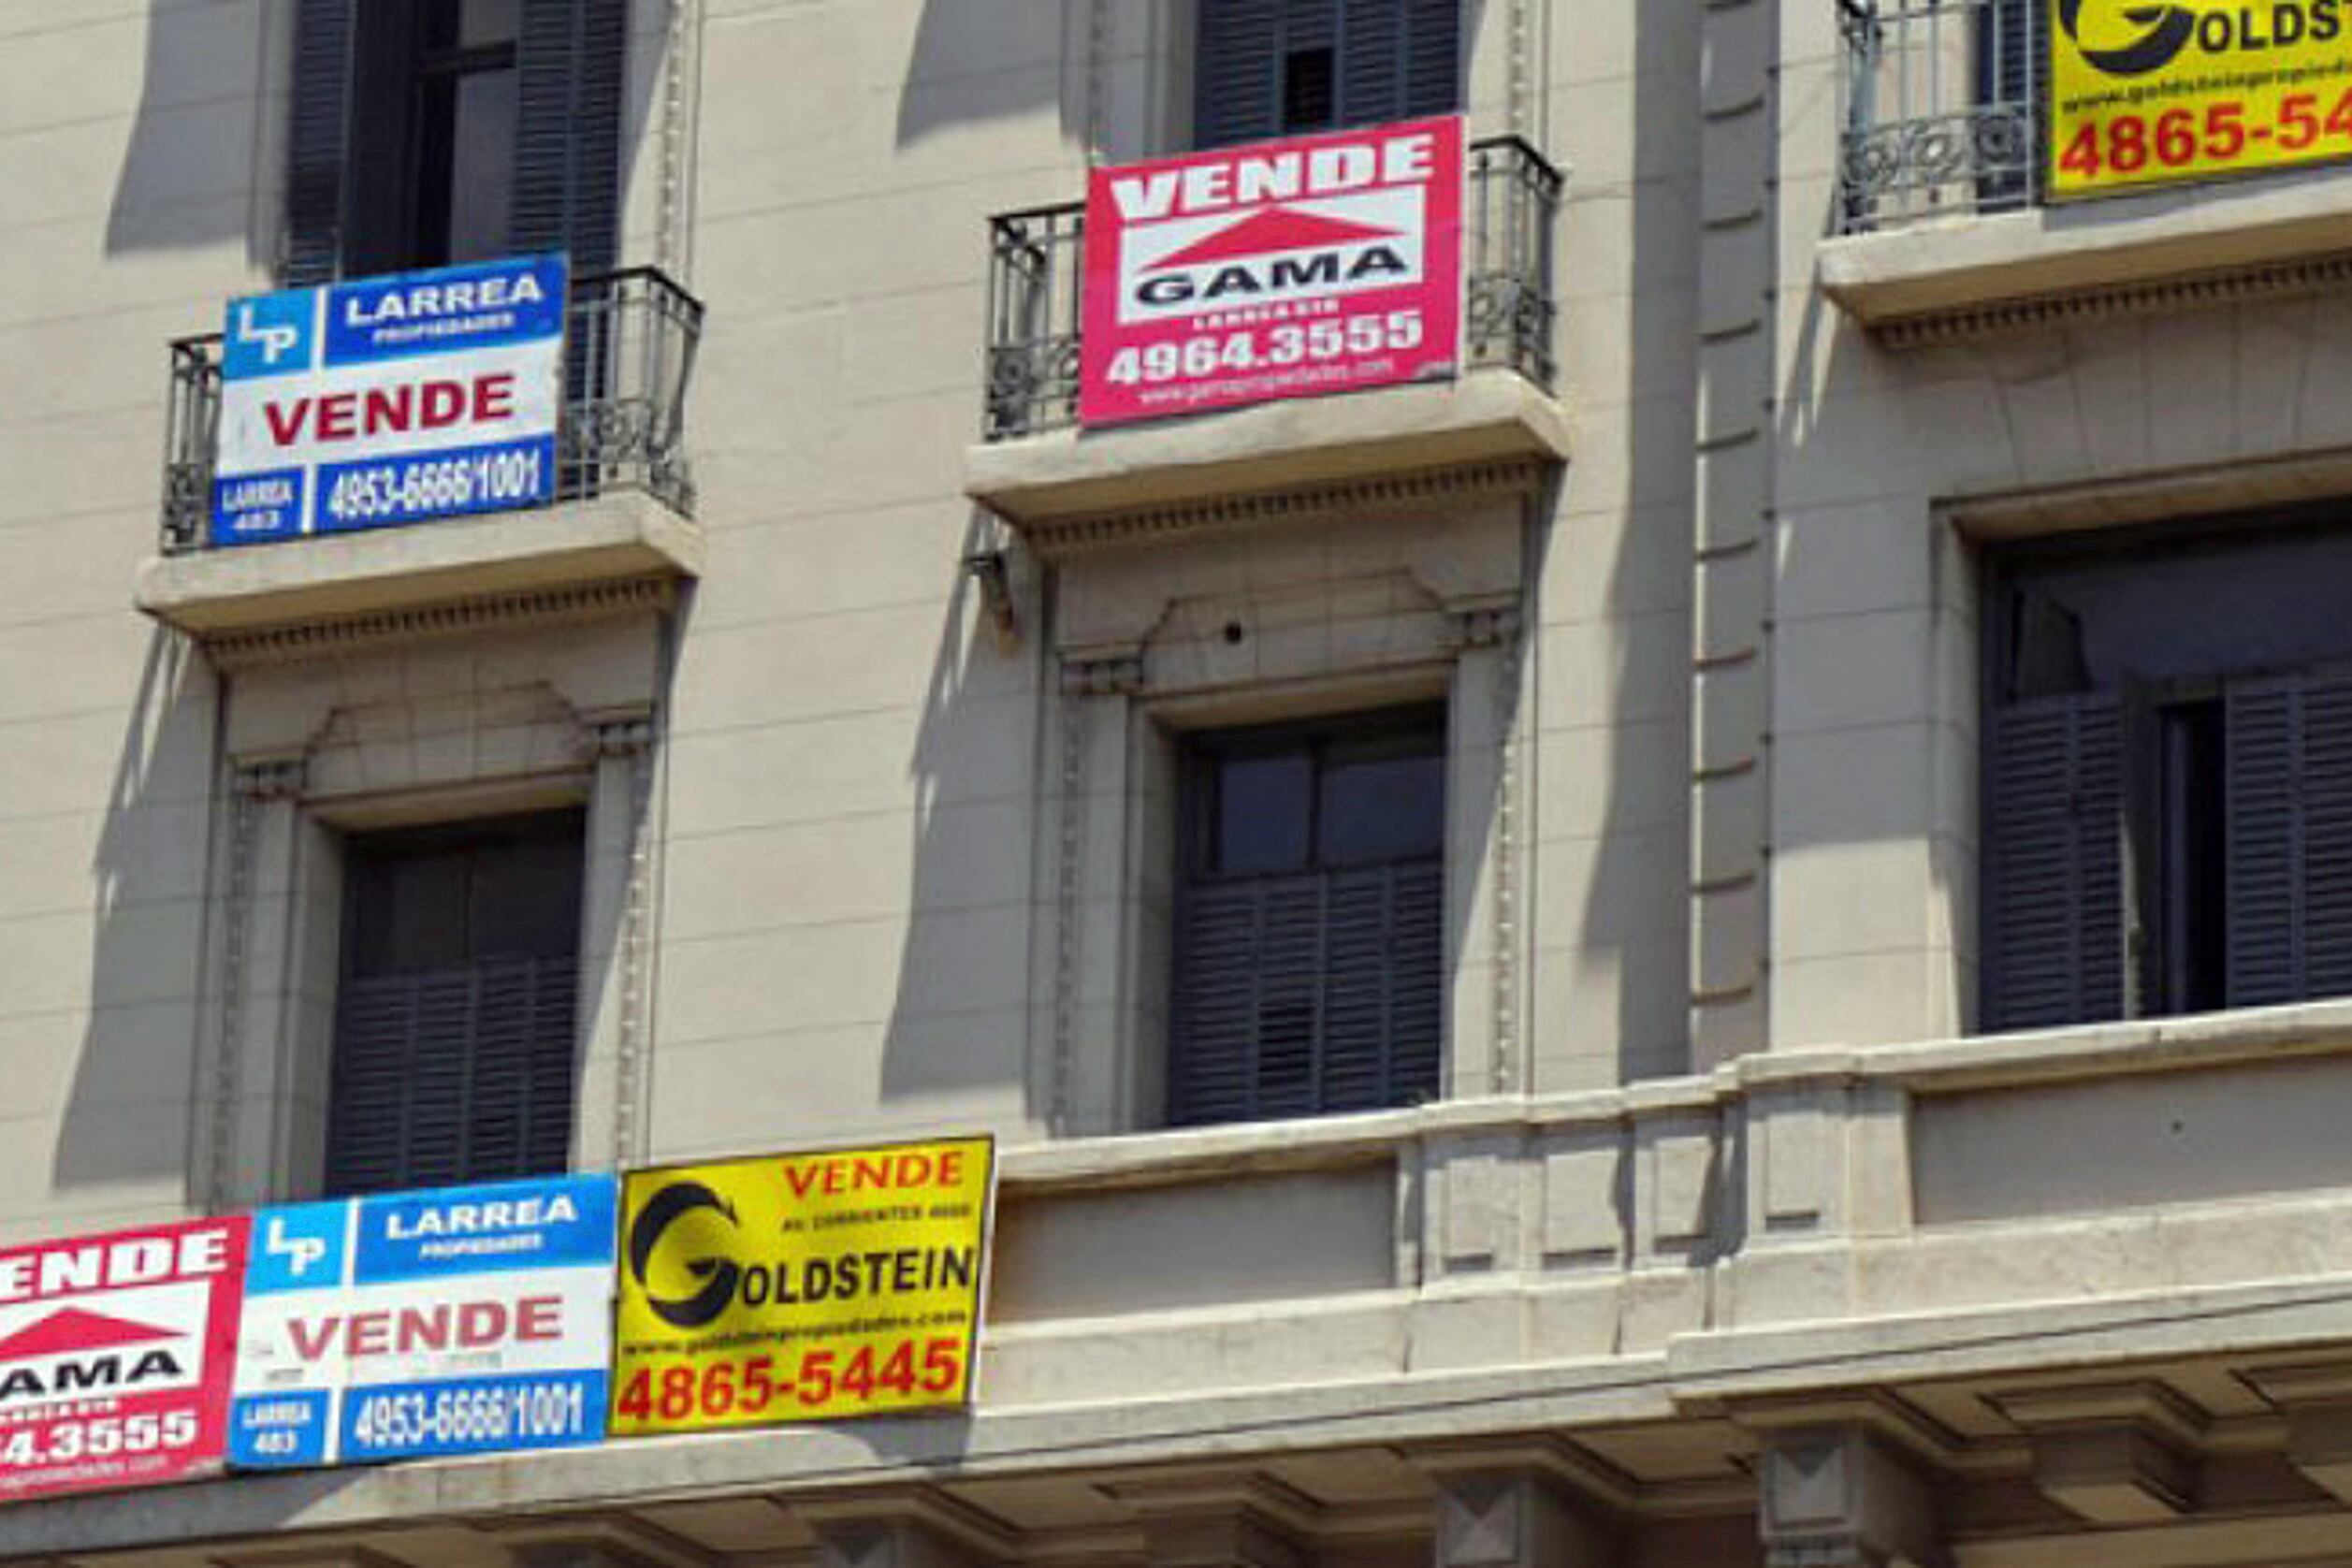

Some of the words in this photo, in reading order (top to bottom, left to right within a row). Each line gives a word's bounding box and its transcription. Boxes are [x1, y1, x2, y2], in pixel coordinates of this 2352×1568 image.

[2060, 86, 2352, 176] 4865-54
[1111, 134, 1434, 219] VENDE
[346, 273, 543, 327] LARREA
[1136, 246, 1407, 305] GAMA
[1108, 311, 1422, 384] 4964.3555
[265, 374, 515, 446] VENDE
[783, 1152, 964, 1199] VENDE
[386, 1196, 576, 1240] LARREA
[630, 1182, 972, 1328] GOLDSTEIN
[287, 1296, 563, 1361] VENDE
[618, 1336, 960, 1421] 4865-5445
